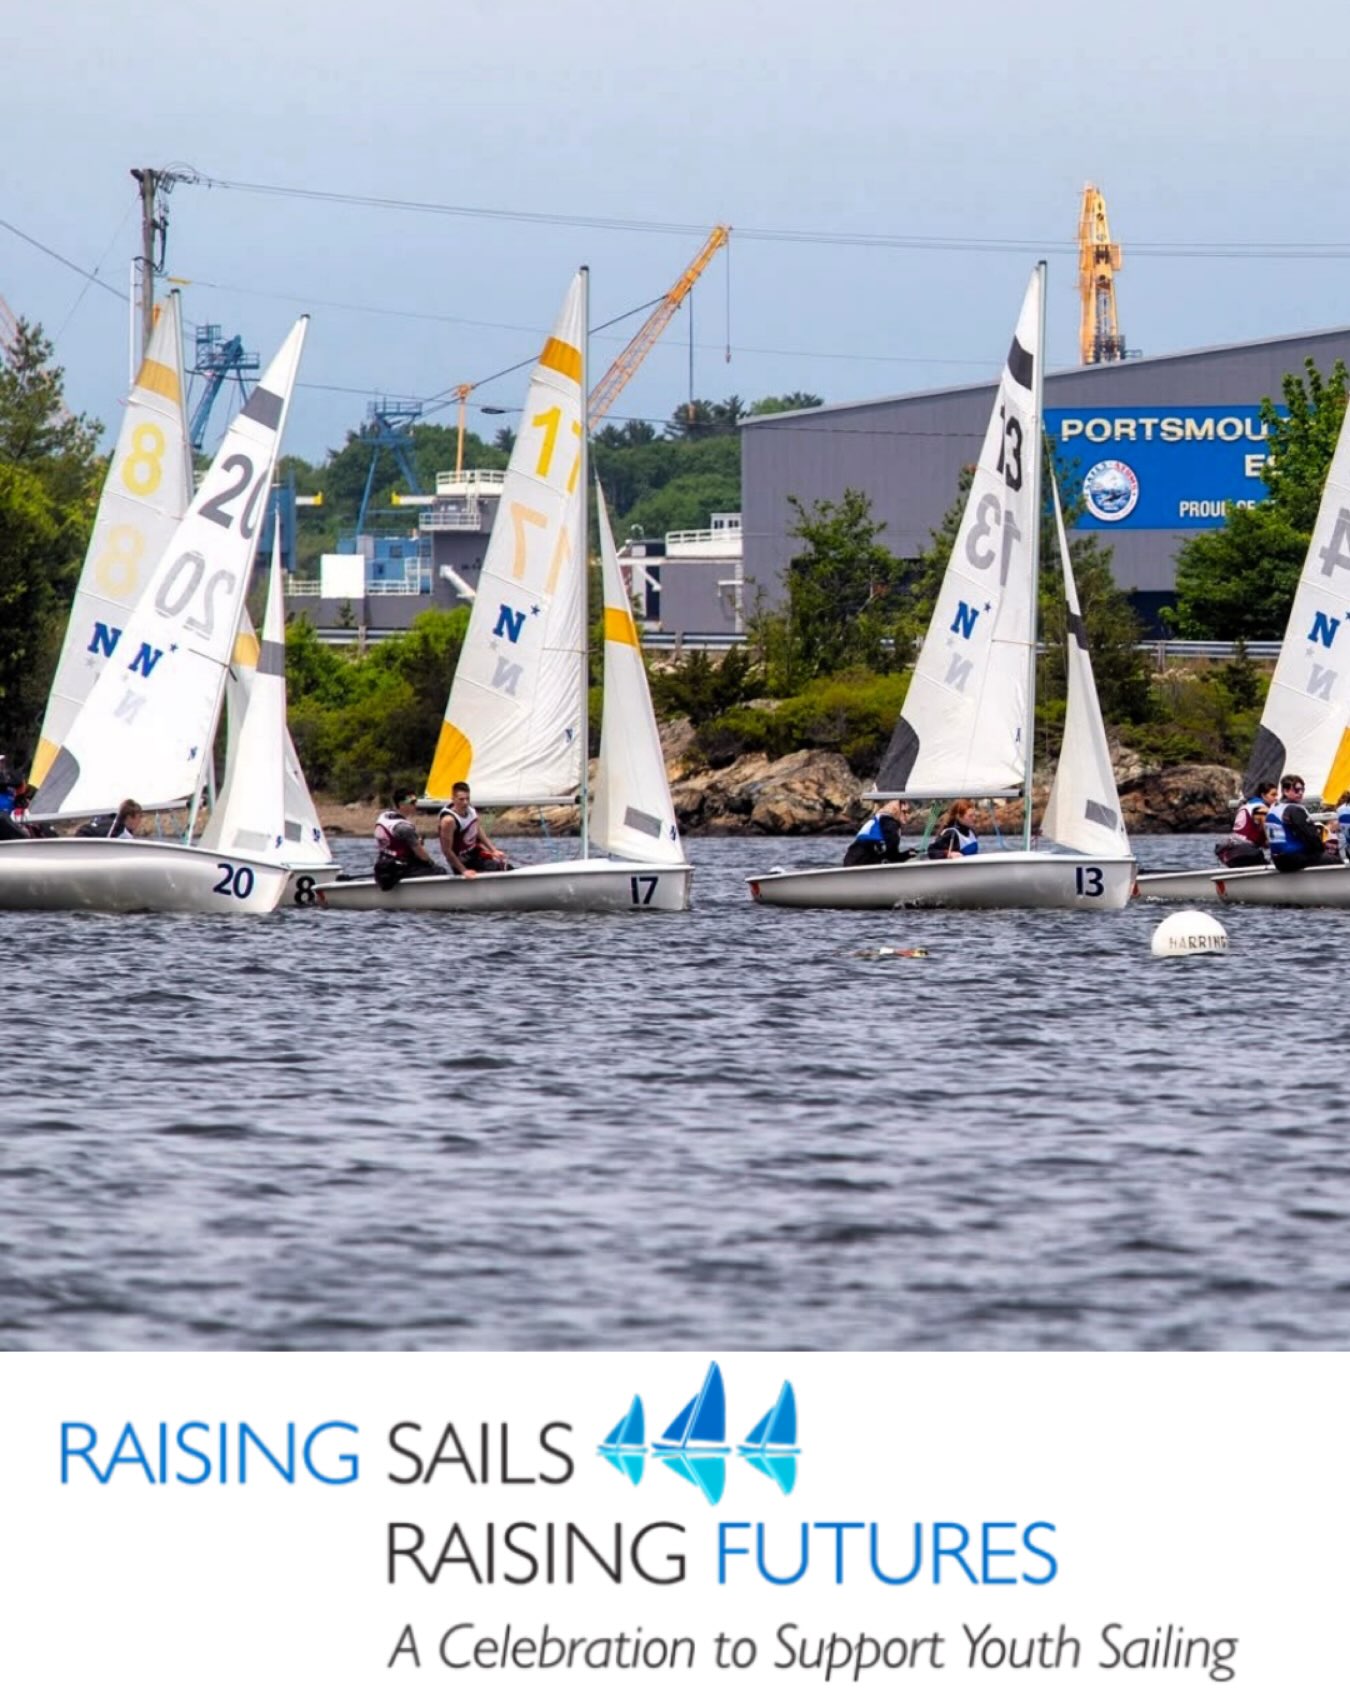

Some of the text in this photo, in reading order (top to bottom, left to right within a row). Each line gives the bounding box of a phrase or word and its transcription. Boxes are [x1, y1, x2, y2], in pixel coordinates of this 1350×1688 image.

[1061, 417, 1289, 443] PORTSMOU
[121, 423, 165, 496] 8
[95, 524, 144, 597] 8
[492, 604, 526, 643] N
[950, 600, 979, 640] N
[1307, 611, 1340, 649] N
[87, 621, 122, 658] N
[128, 642, 163, 678] N
[213, 863, 254, 898] 20
[294, 876, 316, 904] 8
[631, 876, 658, 904] 17
[1076, 866, 1104, 896] 13
